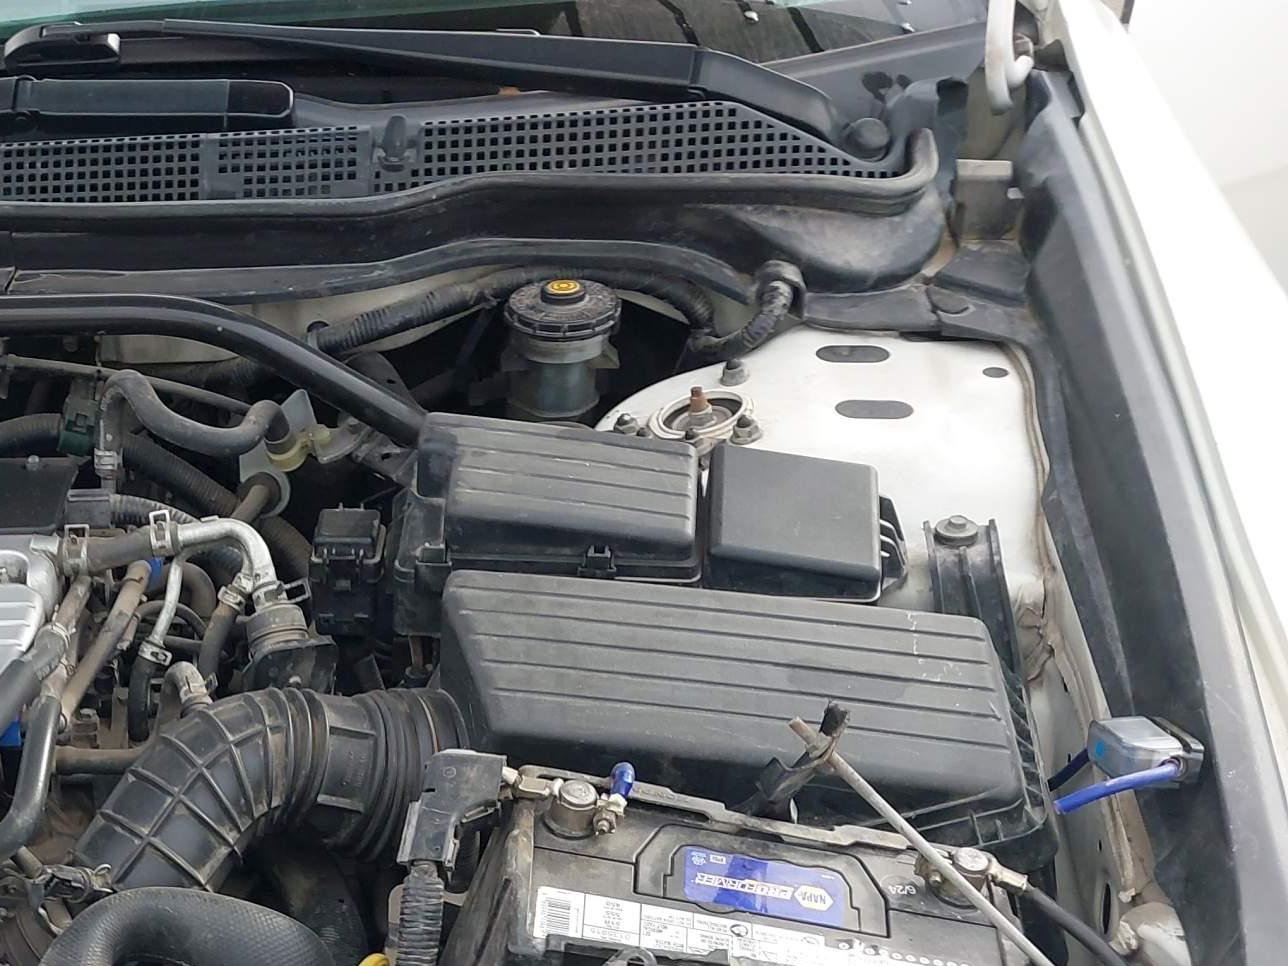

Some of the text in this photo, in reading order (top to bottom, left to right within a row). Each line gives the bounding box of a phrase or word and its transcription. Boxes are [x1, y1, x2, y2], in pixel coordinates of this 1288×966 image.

[695, 871, 827, 906] NAPA PROFORMER
[888, 884, 917, 896] 6/24
